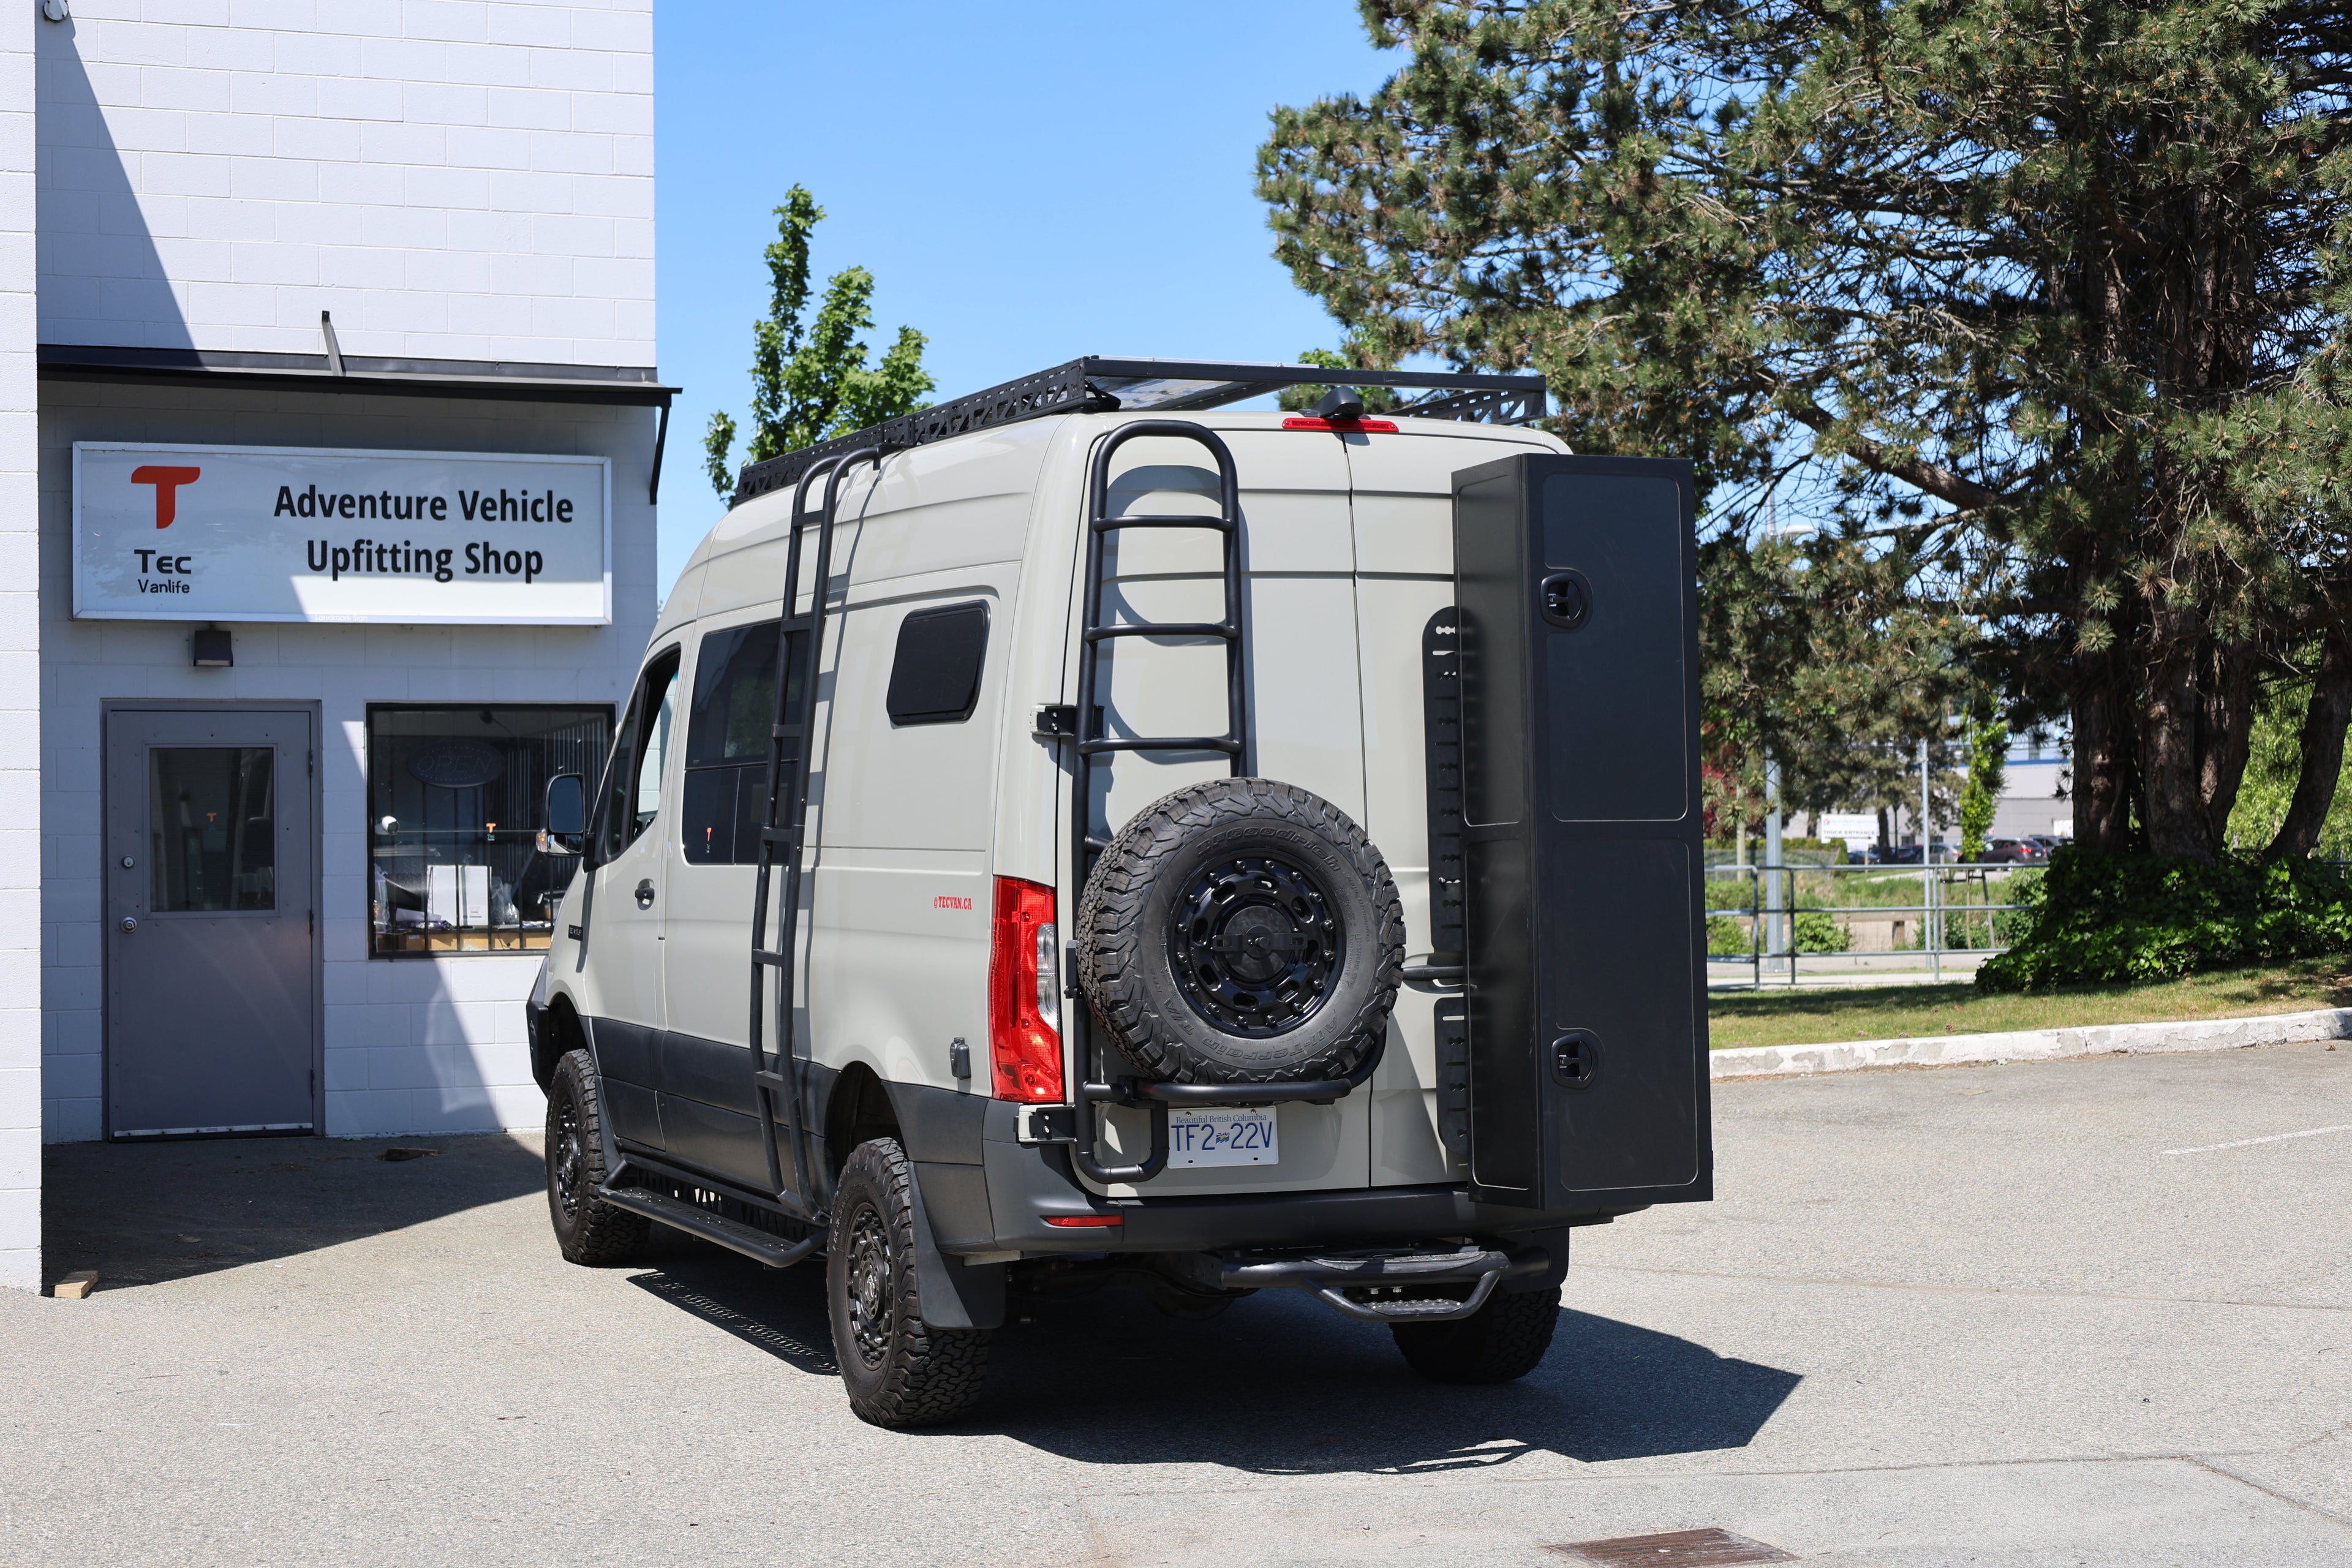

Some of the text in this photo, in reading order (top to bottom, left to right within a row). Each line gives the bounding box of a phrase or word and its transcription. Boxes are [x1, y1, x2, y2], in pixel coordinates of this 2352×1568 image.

[274, 484, 574, 523] Adventure Vehicle
[307, 539, 543, 583] Upfitting Shop
[138, 579, 190, 594] Vanlife
[417, 754, 492, 773] OPEN
[933, 896, 972, 910] @TECVAN.CA
[1176, 1113, 1267, 1124] Beautiful British Columbia
[1170, 1121, 1273, 1152] TF2 22V
